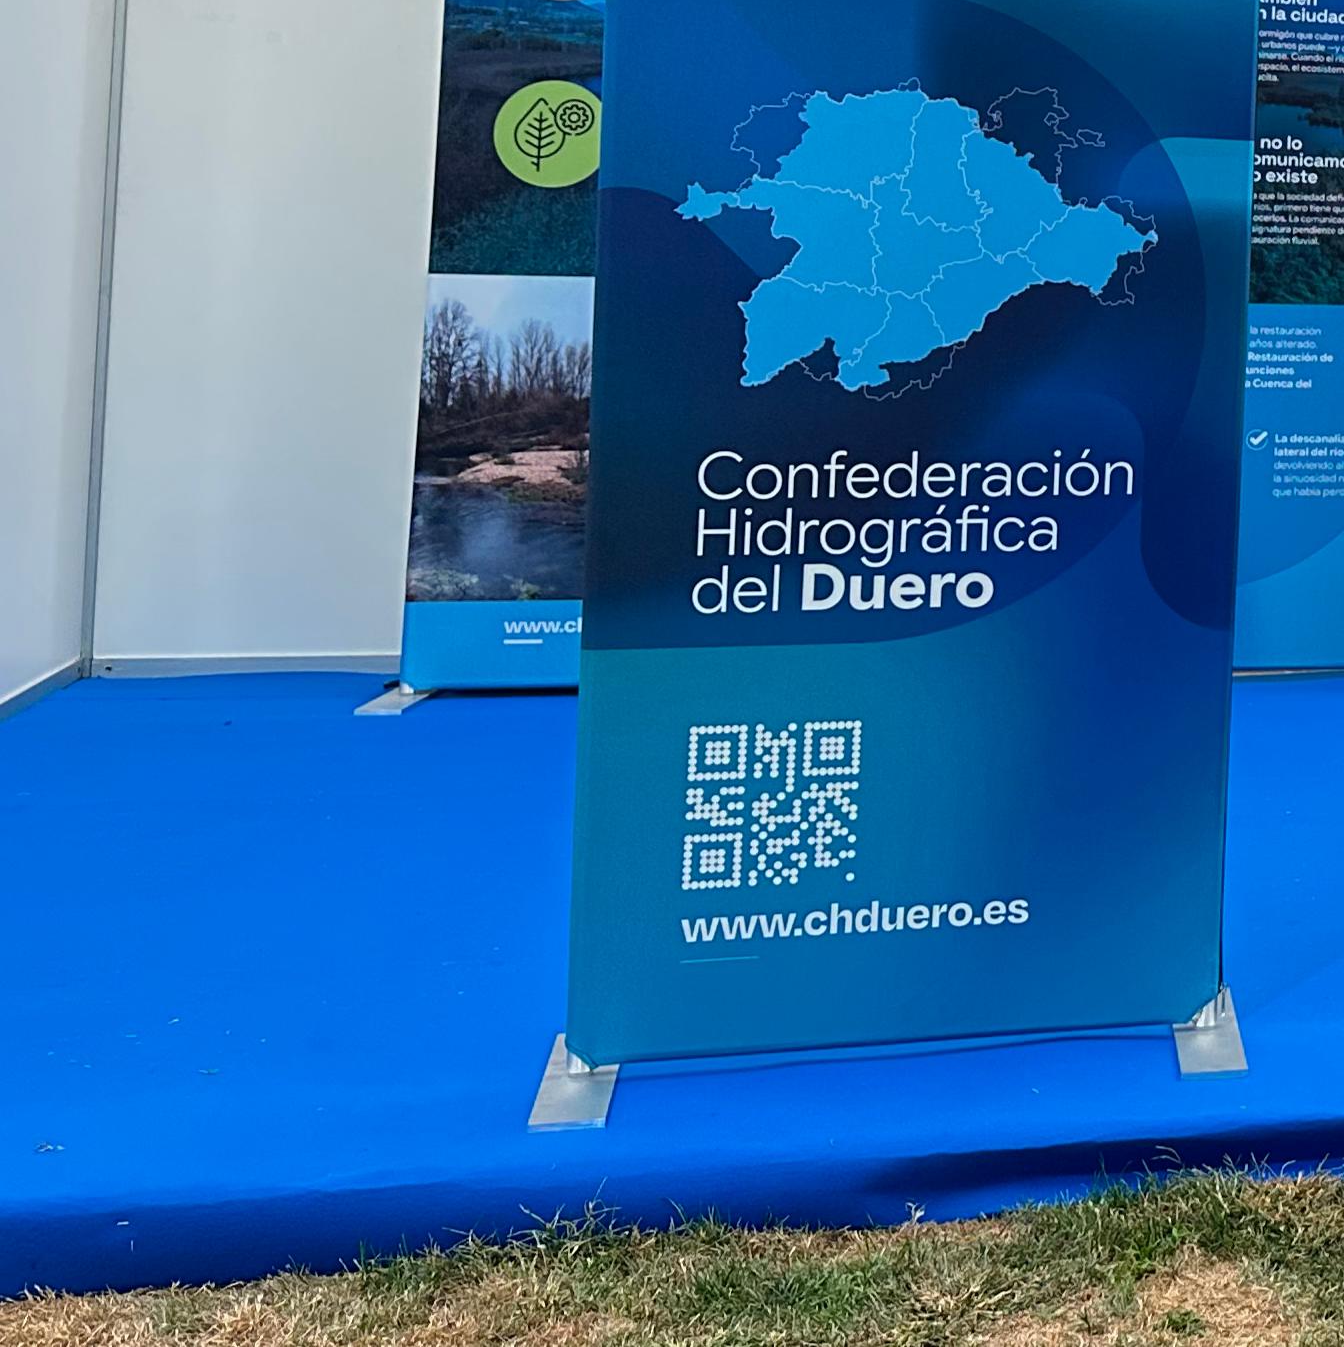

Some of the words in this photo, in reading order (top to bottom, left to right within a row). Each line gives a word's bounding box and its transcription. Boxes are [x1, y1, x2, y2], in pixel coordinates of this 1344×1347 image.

[1275, 434, 1287, 443] La
[698, 449, 1134, 500] Confederación
[697, 504, 1059, 568] Hidrográfica
[692, 564, 780, 614] del
[801, 563, 994, 612] Duero
[681, 898, 1029, 943] www.chduero.es
